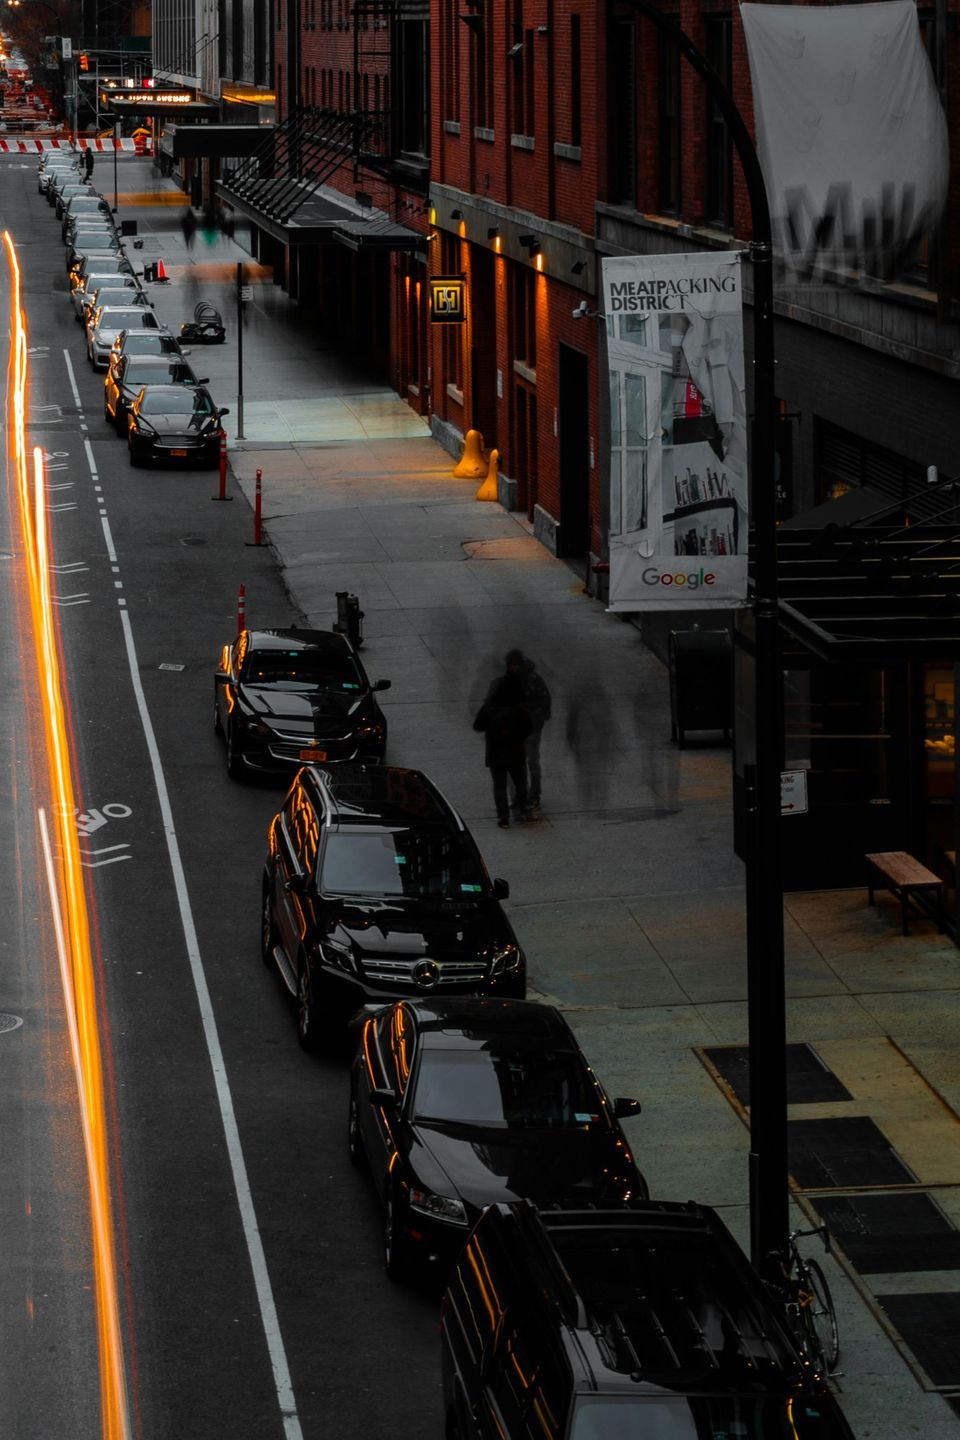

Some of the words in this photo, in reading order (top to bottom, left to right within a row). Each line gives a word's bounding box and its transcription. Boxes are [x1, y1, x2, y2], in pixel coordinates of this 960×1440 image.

[610, 276, 737, 296] MEATPACKING
[611, 294, 689, 311] DISTRICT
[642, 567, 716, 590] Google
